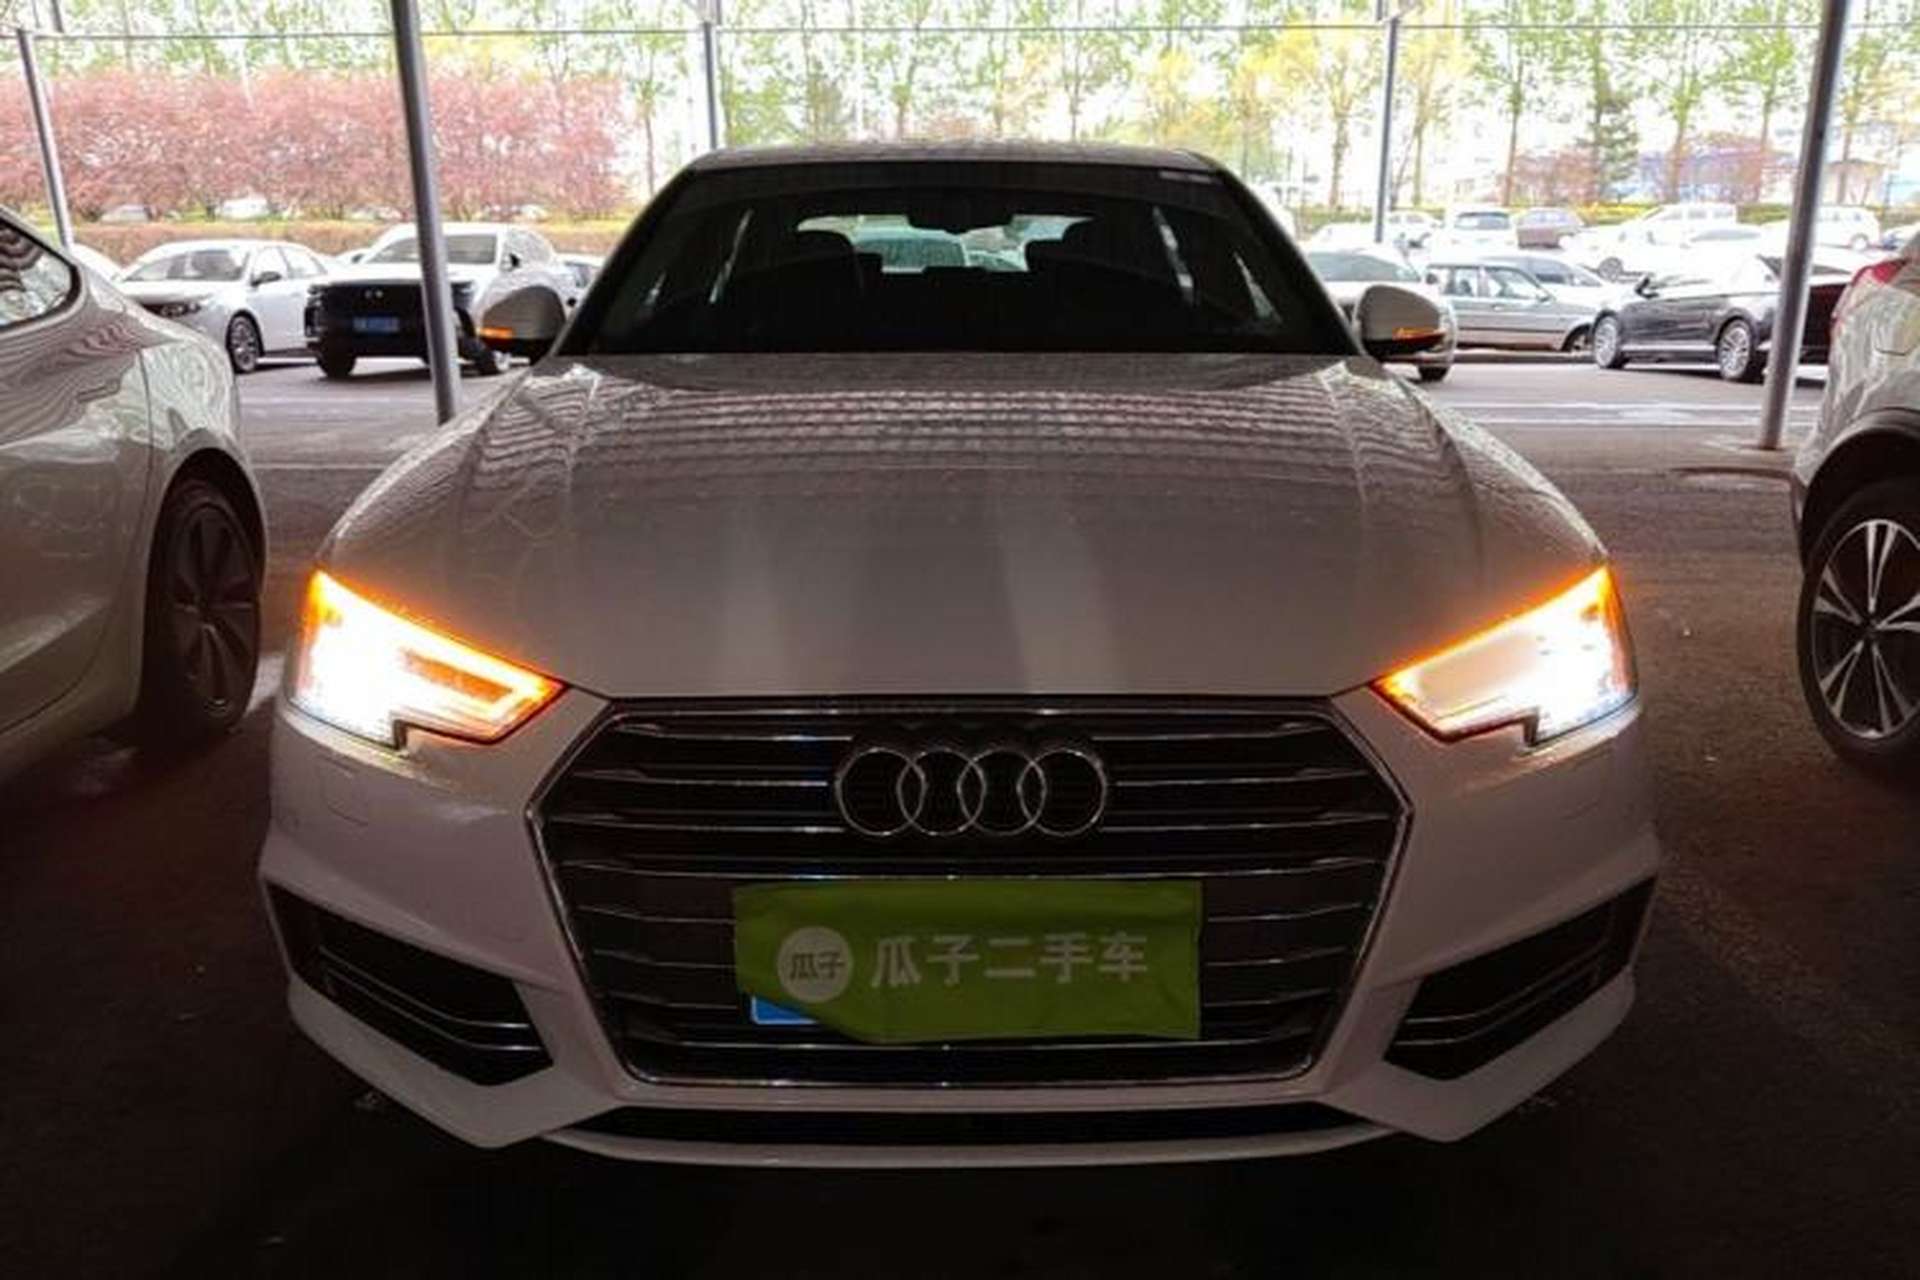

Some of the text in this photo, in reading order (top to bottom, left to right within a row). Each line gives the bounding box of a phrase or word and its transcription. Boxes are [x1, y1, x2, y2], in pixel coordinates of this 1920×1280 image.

[789, 952, 845, 980] 瓜子
[871, 932, 1148, 987] 瓜子二手车
